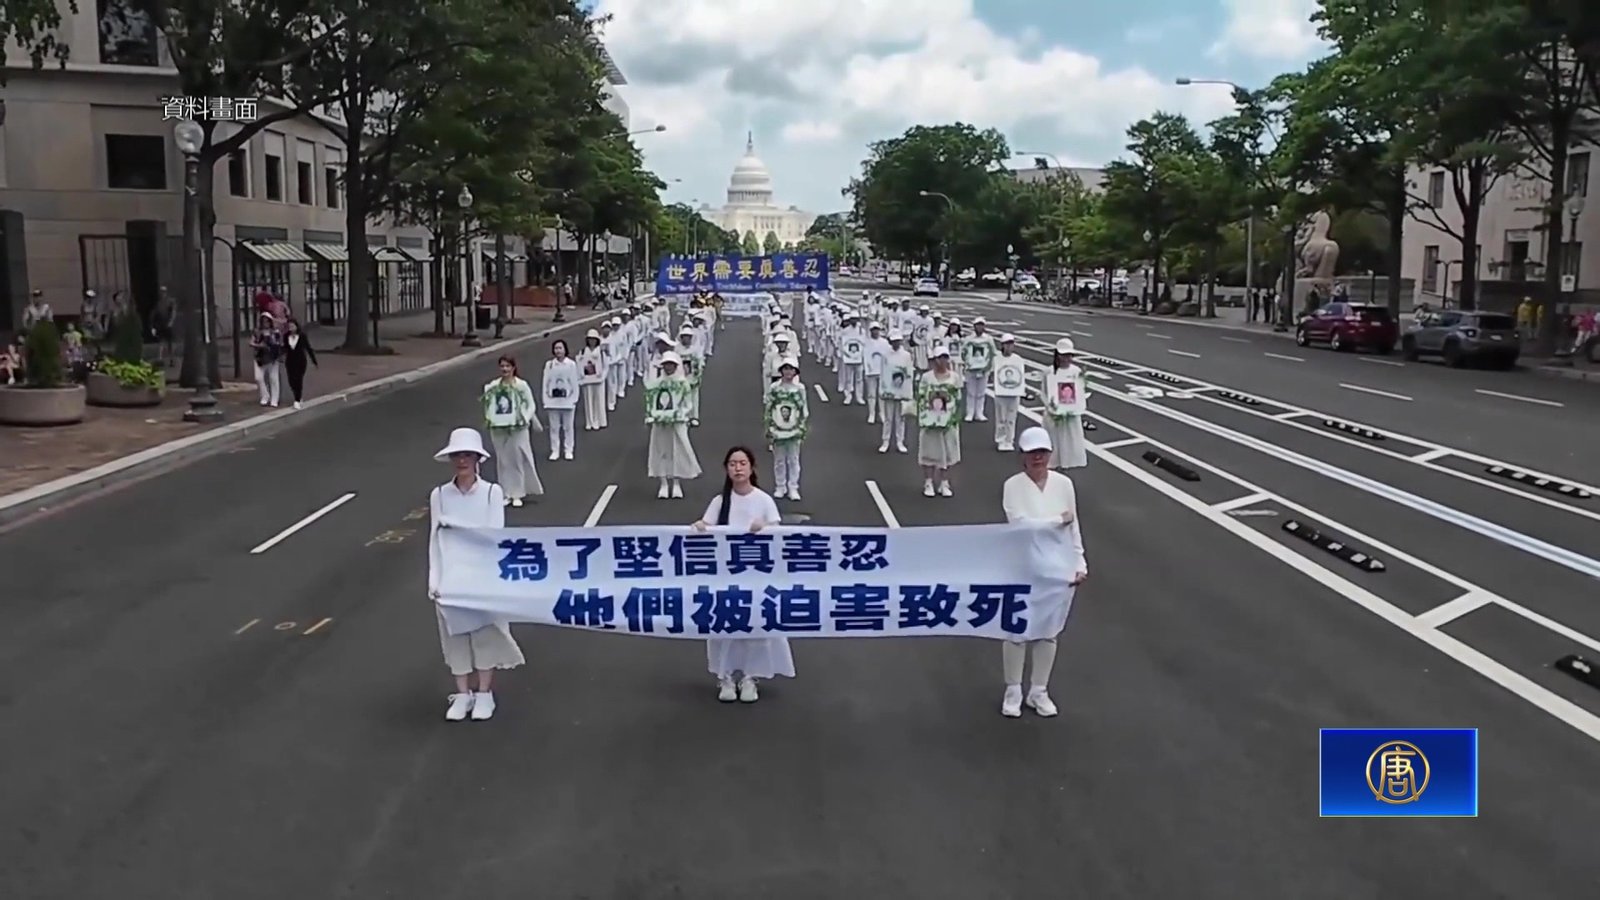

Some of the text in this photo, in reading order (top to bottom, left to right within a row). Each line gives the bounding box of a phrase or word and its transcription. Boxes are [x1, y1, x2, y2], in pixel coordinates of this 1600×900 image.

[498, 533, 889, 581] 為了堅信真善忍
[552, 584, 1032, 635] 他們被迫害致死
